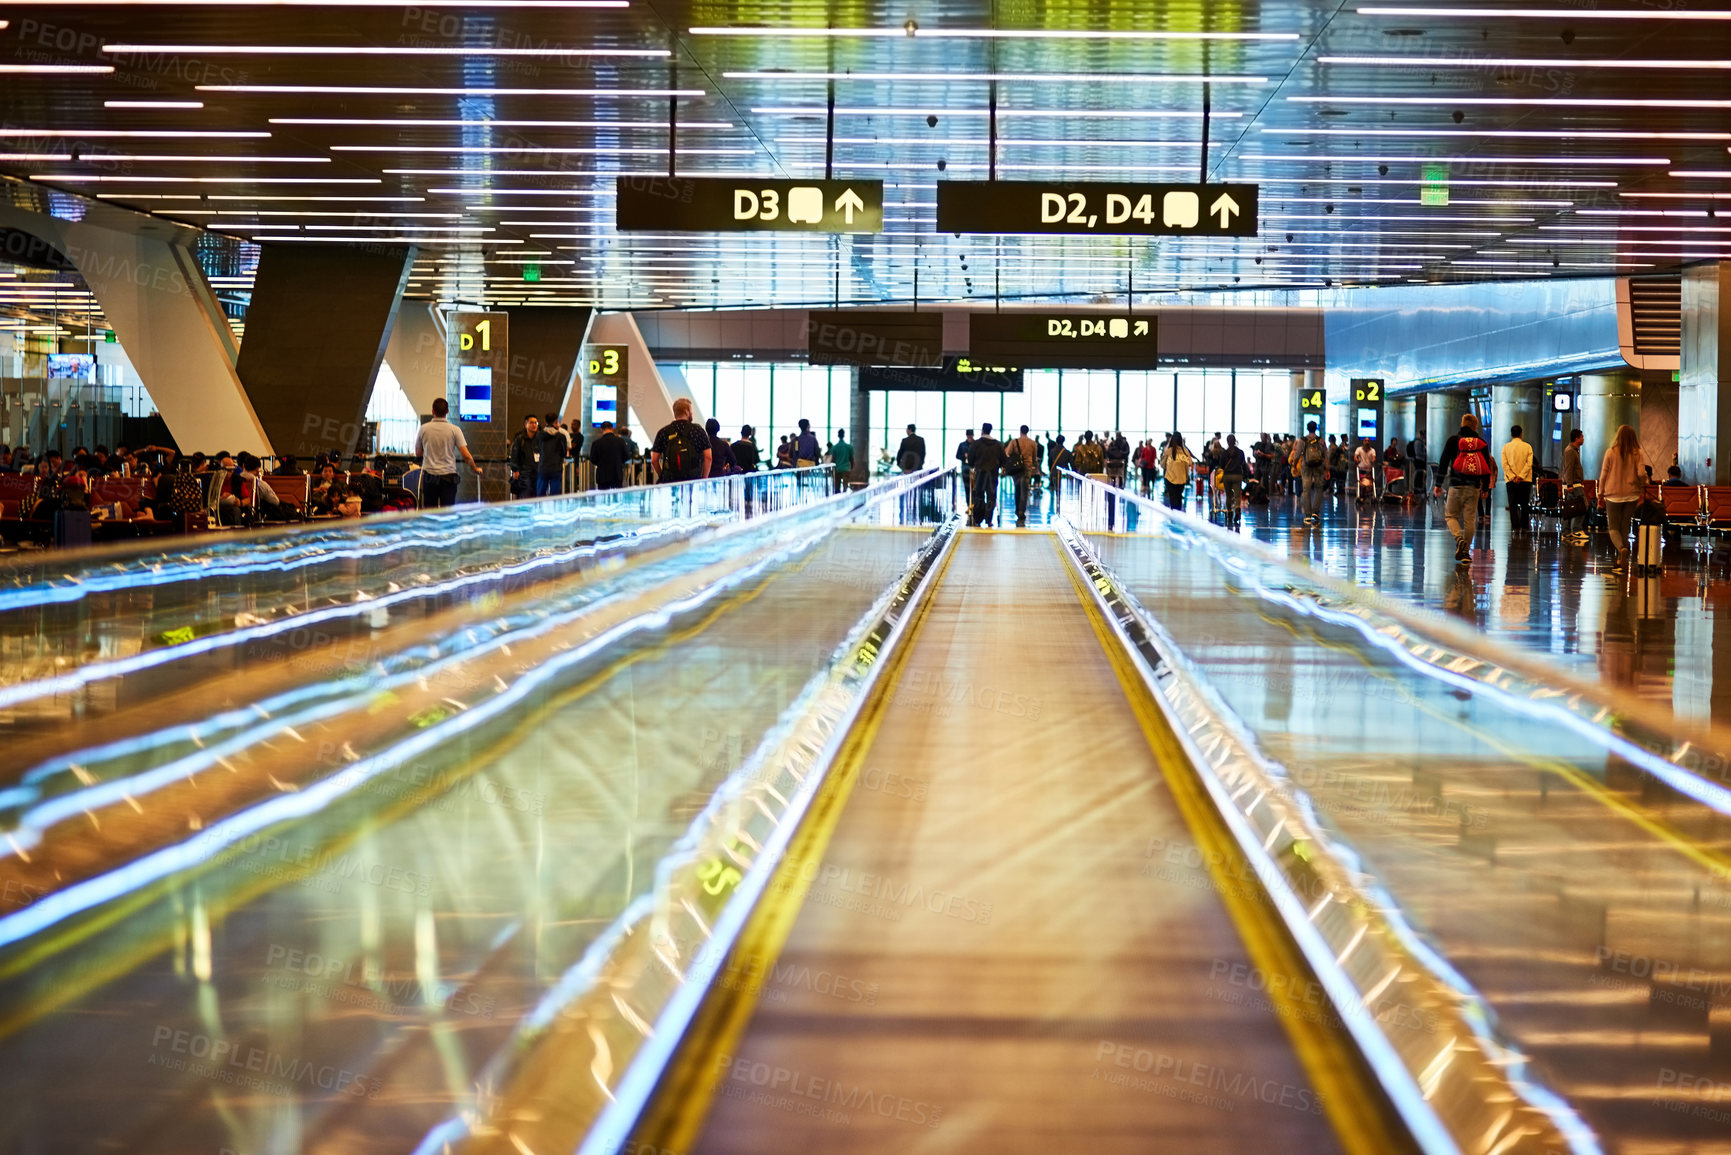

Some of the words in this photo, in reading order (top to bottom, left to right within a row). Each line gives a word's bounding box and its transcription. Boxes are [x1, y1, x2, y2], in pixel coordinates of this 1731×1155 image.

[734, 189, 779, 220] D3
[1041, 193, 1098, 228] D2,
[1106, 194, 1155, 224] D4
[1048, 319, 1077, 338] D2,
[1080, 320, 1106, 336] D4
